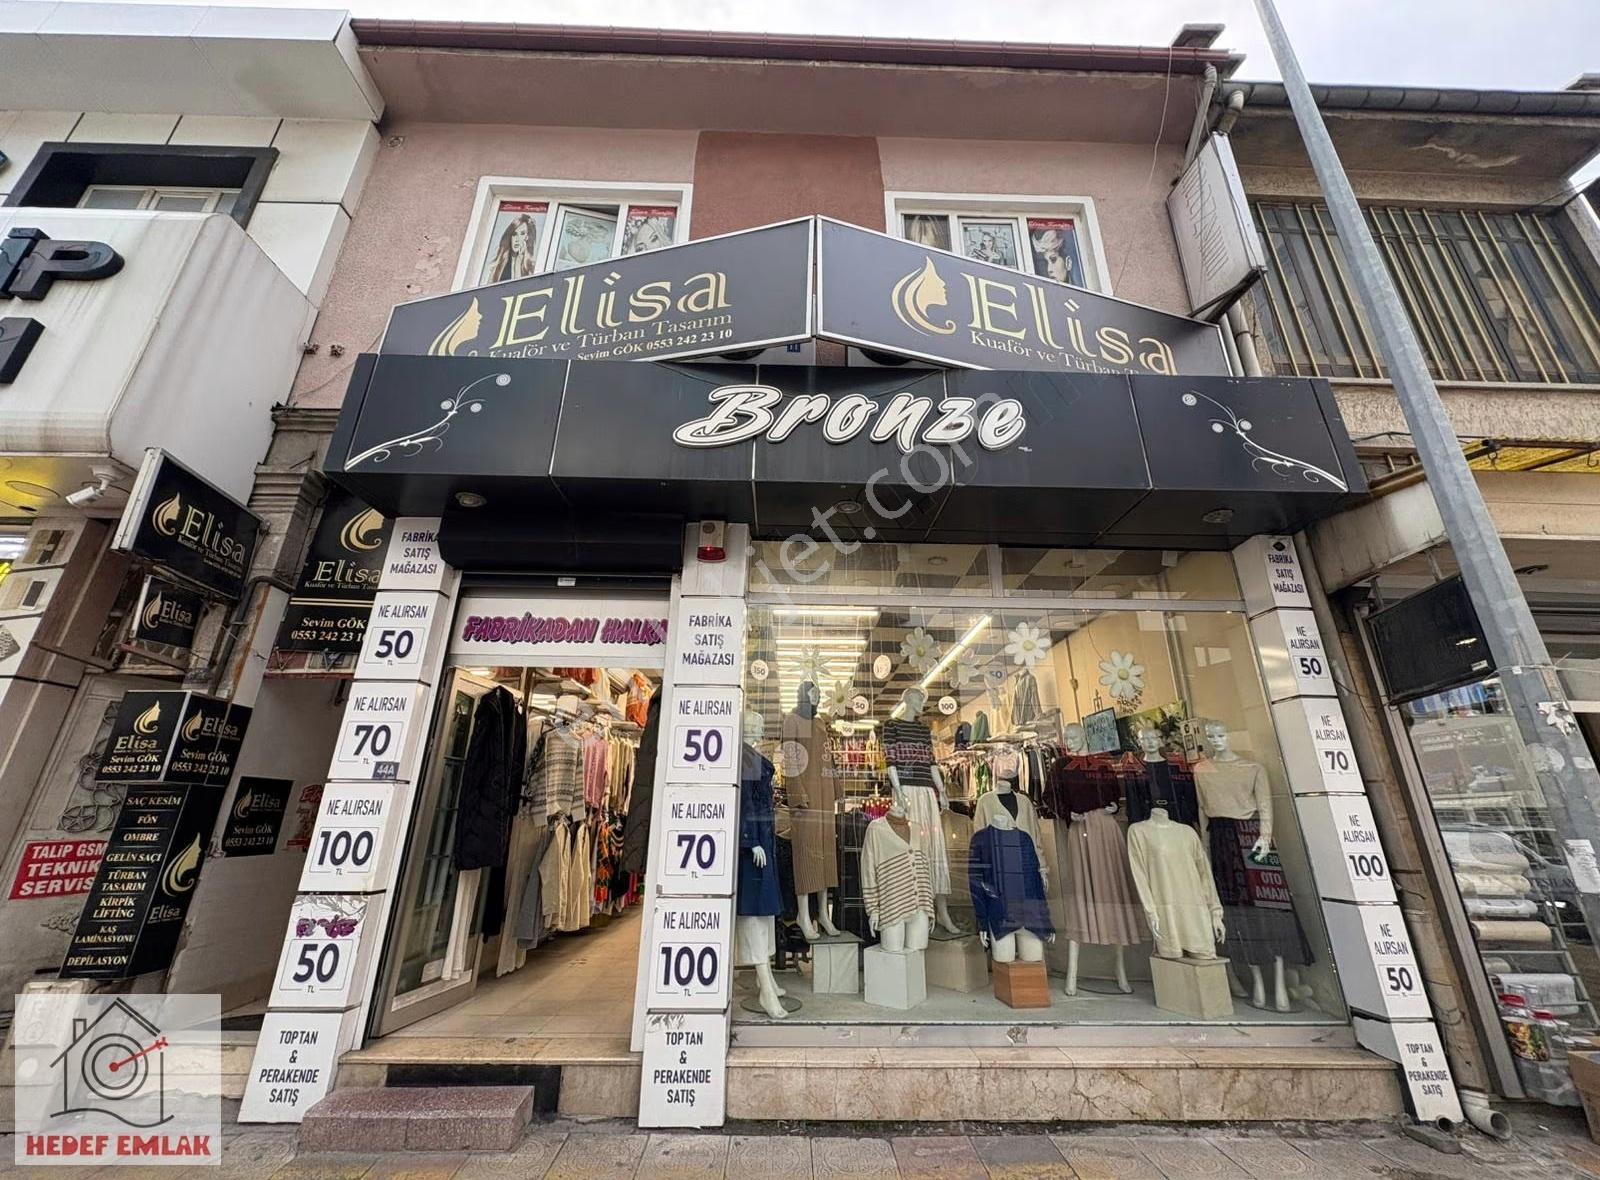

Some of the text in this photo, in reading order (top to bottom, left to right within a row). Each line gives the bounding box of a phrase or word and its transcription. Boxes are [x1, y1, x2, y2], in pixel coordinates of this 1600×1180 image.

[488, 270, 732, 350] Elisa
[960, 272, 1178, 376] Elisa
[552, 340, 571, 352] ve
[577, 325, 645, 349] Türban
[651, 313, 733, 336] Tasarım
[577, 328, 733, 360] Sevim GÖK 0553 242 23 10
[970, 330, 1032, 358] Kuaför
[1037, 350, 1056, 363] ve
[673, 383, 1026, 455] Bronze
[179, 503, 246, 565] Elisa
[401, 529, 438, 543] FABRİK
[403, 547, 431, 561] SATIŞ
[1268, 553, 1294, 565] FABRİKA
[313, 559, 382, 583] Elisa
[390, 561, 438, 574] MAĞAZASI
[1276, 568, 1294, 583] SATIŞ
[1273, 580, 1304, 594] MAĞAZASI
[160, 600, 193, 625] Elisa
[378, 605, 428, 619] NE ALIRSAN
[301, 616, 366, 630] Sevim GÖK
[462, 611, 600, 645] FABRİKADAN
[689, 612, 733, 629] FABRİKA
[291, 629, 365, 643] 0553 242 23 1
[1296, 626, 1307, 637] NE
[374, 629, 414, 659] 50
[694, 633, 725, 650] SATIŞ
[1290, 636, 1321, 650] ALIRSAN
[682, 649, 735, 667] MAĞAZASI
[1299, 657, 1323, 677] 50
[354, 697, 406, 712] NE ALIRSAN
[679, 700, 732, 716] NE ALIRSAN
[202, 717, 239, 737] Elisa
[1321, 715, 1332, 727] NE
[114, 734, 158, 751] Elisa
[354, 724, 391, 757] 70
[1315, 728, 1346, 742] ALIRSAN
[683, 728, 723, 763] 50
[110, 753, 160, 764] Sevim GÖK
[181, 749, 230, 763] Sevim GÖK
[1325, 751, 1349, 771] 70
[102, 764, 162, 774] 0553 242 23 10
[171, 761, 230, 776] 0553 242 23 10
[126, 795, 182, 807] SAÇ KESİM
[250, 793, 281, 809] Elisa
[327, 799, 383, 816] NE ALIRSAN
[672, 803, 725, 820] NE ALIRSAN
[137, 815, 159, 825] FÖN
[1349, 814, 1361, 827] NE
[123, 832, 160, 841] OMBRE
[1343, 829, 1376, 844] ALIRSAN
[76, 842, 109, 856] GSM
[316, 829, 374, 866] 100
[677, 833, 716, 871] 70
[106, 852, 162, 863] GELİN SAÇI
[1349, 853, 1384, 877] 100
[108, 870, 148, 880] TÜRBAN
[334, 867, 343, 876] TL
[691, 871, 699, 879] TL
[102, 882, 146, 891] TASARIM
[100, 896, 137, 907] KİRPİK
[92, 907, 135, 919] LİFTİNG
[149, 904, 181, 920] Elisa
[663, 911, 721, 930] NE ALIRSAN
[100, 925, 118, 935] KAŞ
[1379, 924, 1391, 937] NE
[74, 933, 137, 944] LAMİNASYONU
[1374, 940, 1409, 956] ALIRSAN
[67, 955, 129, 967] DEPİLASYON
[292, 943, 341, 983] 50
[661, 946, 718, 987] 100
[1386, 966, 1413, 992] 50
[306, 985, 315, 994] TL
[684, 988, 692, 997] TL
[279, 1030, 319, 1045] TOPTAN
[666, 1031, 704, 1046] TOPTAN
[1406, 1042, 1434, 1054] TOPTAN
[288, 1050, 298, 1064] &
[679, 1050, 687, 1064] &
[1421, 1056, 1428, 1067] &
[258, 1068, 320, 1084] PERAKENDE
[653, 1069, 712, 1084] PERAKENDE
[1408, 1069, 1450, 1082] PERAKENDE
[268, 1088, 299, 1107] SATIŞ
[666, 1088, 696, 1107] SATIŞ
[1421, 1083, 1444, 1097] SATIŞ
